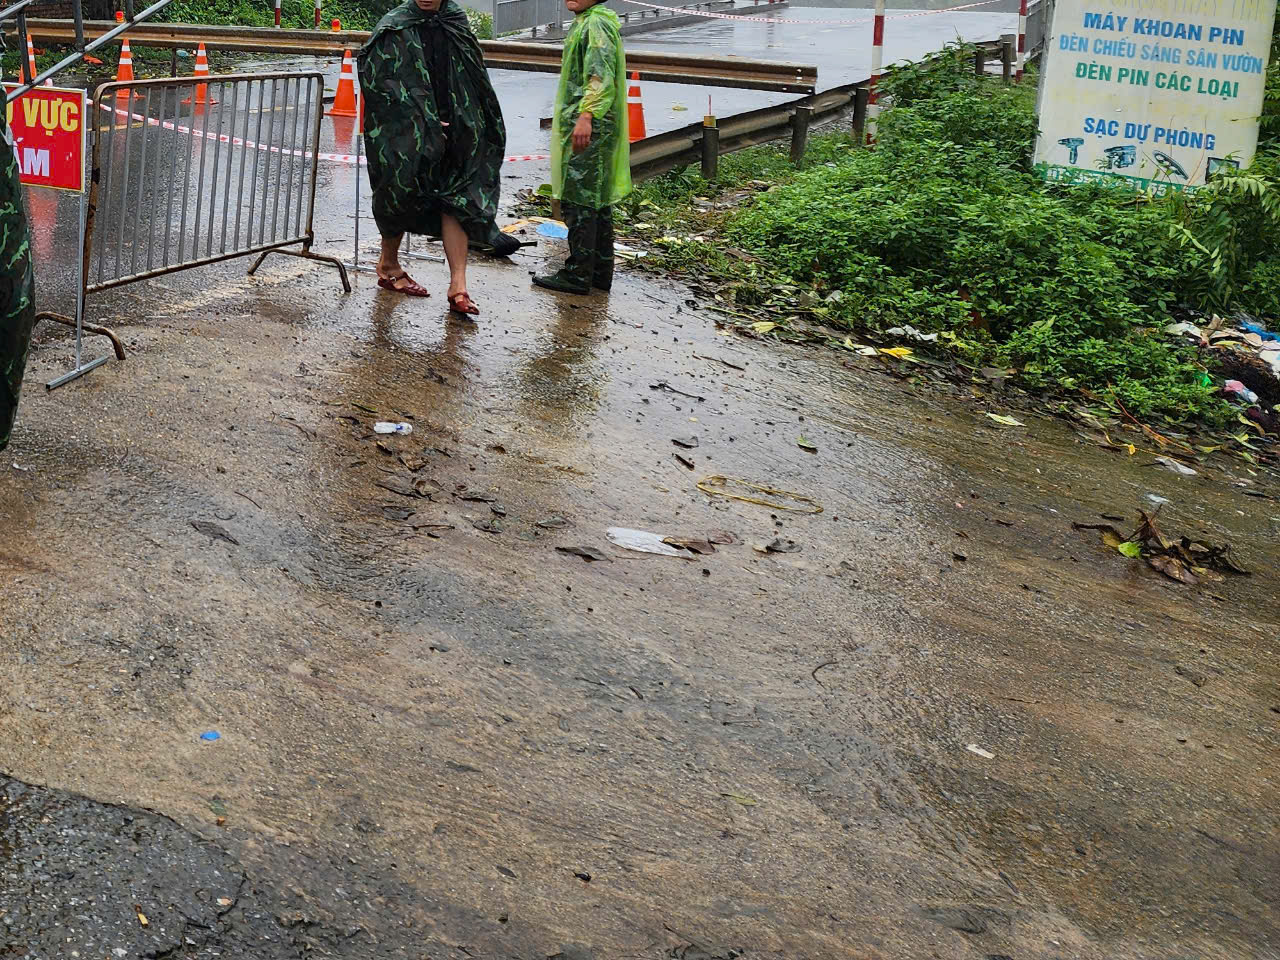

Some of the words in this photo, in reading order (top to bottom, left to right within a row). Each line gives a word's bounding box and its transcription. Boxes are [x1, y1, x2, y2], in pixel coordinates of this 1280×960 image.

[1083, 11, 1128, 32] MÁY
[1133, 17, 1202, 41] KHOAN
[1208, 26, 1245, 46] PIN
[1059, 32, 1089, 53] ĐÈN
[1093, 36, 1136, 58] CHIẾU
[1140, 42, 1181, 64] SÁNG
[1186, 47, 1218, 69] SÂN
[1222, 51, 1263, 74] VƯỜN
[1075, 60, 1112, 82] ĐÈN
[1117, 67, 1150, 87] PIN
[1155, 71, 1192, 92] CÁC
[1197, 77, 1239, 100] LOẠI
[22, 97, 79, 136] VỰC
[1083, 117, 1119, 138] SẠC
[1124, 123, 1151, 144] DỰ
[1153, 127, 1216, 151] PHÒNG
